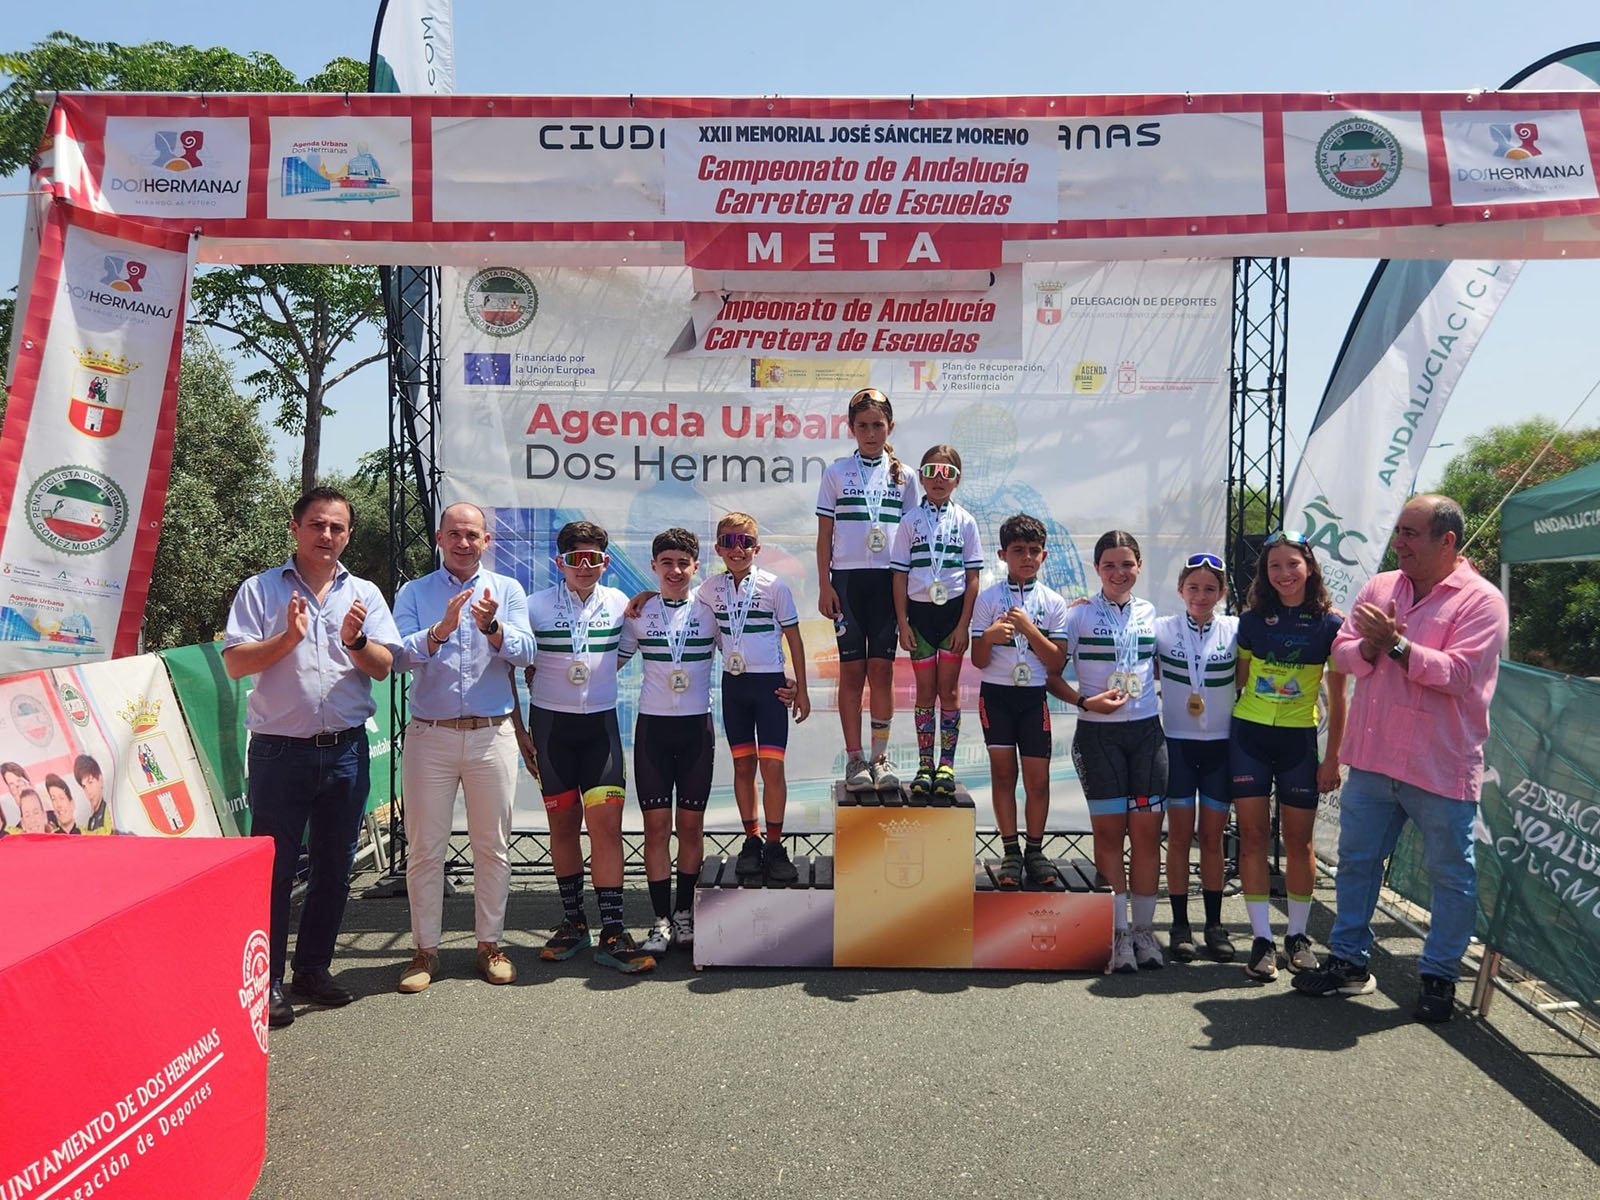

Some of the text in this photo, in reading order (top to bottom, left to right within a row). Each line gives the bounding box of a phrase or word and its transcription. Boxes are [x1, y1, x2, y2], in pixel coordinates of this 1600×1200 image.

[321, 140, 348, 148] Urbana
[539, 124, 665, 150] CIUD
[699, 124, 1029, 146] XXII MEMORIAL JOSÉ SÁNCHEZ MORENO
[1323, 124, 1353, 151] CICLISTA
[1355, 123, 1374, 131] DOS
[1374, 128, 1397, 173] HERMANAS
[698, 155, 1029, 184] Campeonato de Andalucía
[715, 188, 1011, 216] Carretera de Escuelas
[747, 231, 941, 263] META
[501, 270, 516, 278] DOS
[718, 299, 996, 323] mpeonato de Andalucía
[1070, 296, 1217, 307] DELEGACIÓN DE DEPORTES
[704, 327, 979, 354] Carretera de Escuelas
[515, 354, 585, 363] Financiado por
[526, 366, 553, 374] Unión
[556, 366, 595, 375] Europea
[942, 362, 1045, 373] Plan de Recuperación,
[1081, 366, 1107, 375] AGENDA
[942, 372, 1014, 381] Transformación
[951, 382, 1000, 391] Resiliencia
[526, 403, 856, 444] Agenda Urban
[526, 444, 838, 483] Dos Herman
[40, 471, 80, 493] CICLISTA
[83, 472, 104, 486] DOS
[104, 484, 123, 534] HERMANAS
[9, 593, 65, 607] Agenda Urbana
[115, 1094, 138, 1123] DE
[136, 1072, 166, 1107] DOS
[164, 1027, 220, 1086] HERMANAS
[136, 1133, 155, 1156] de
[158, 1081, 213, 1136] Deportes
